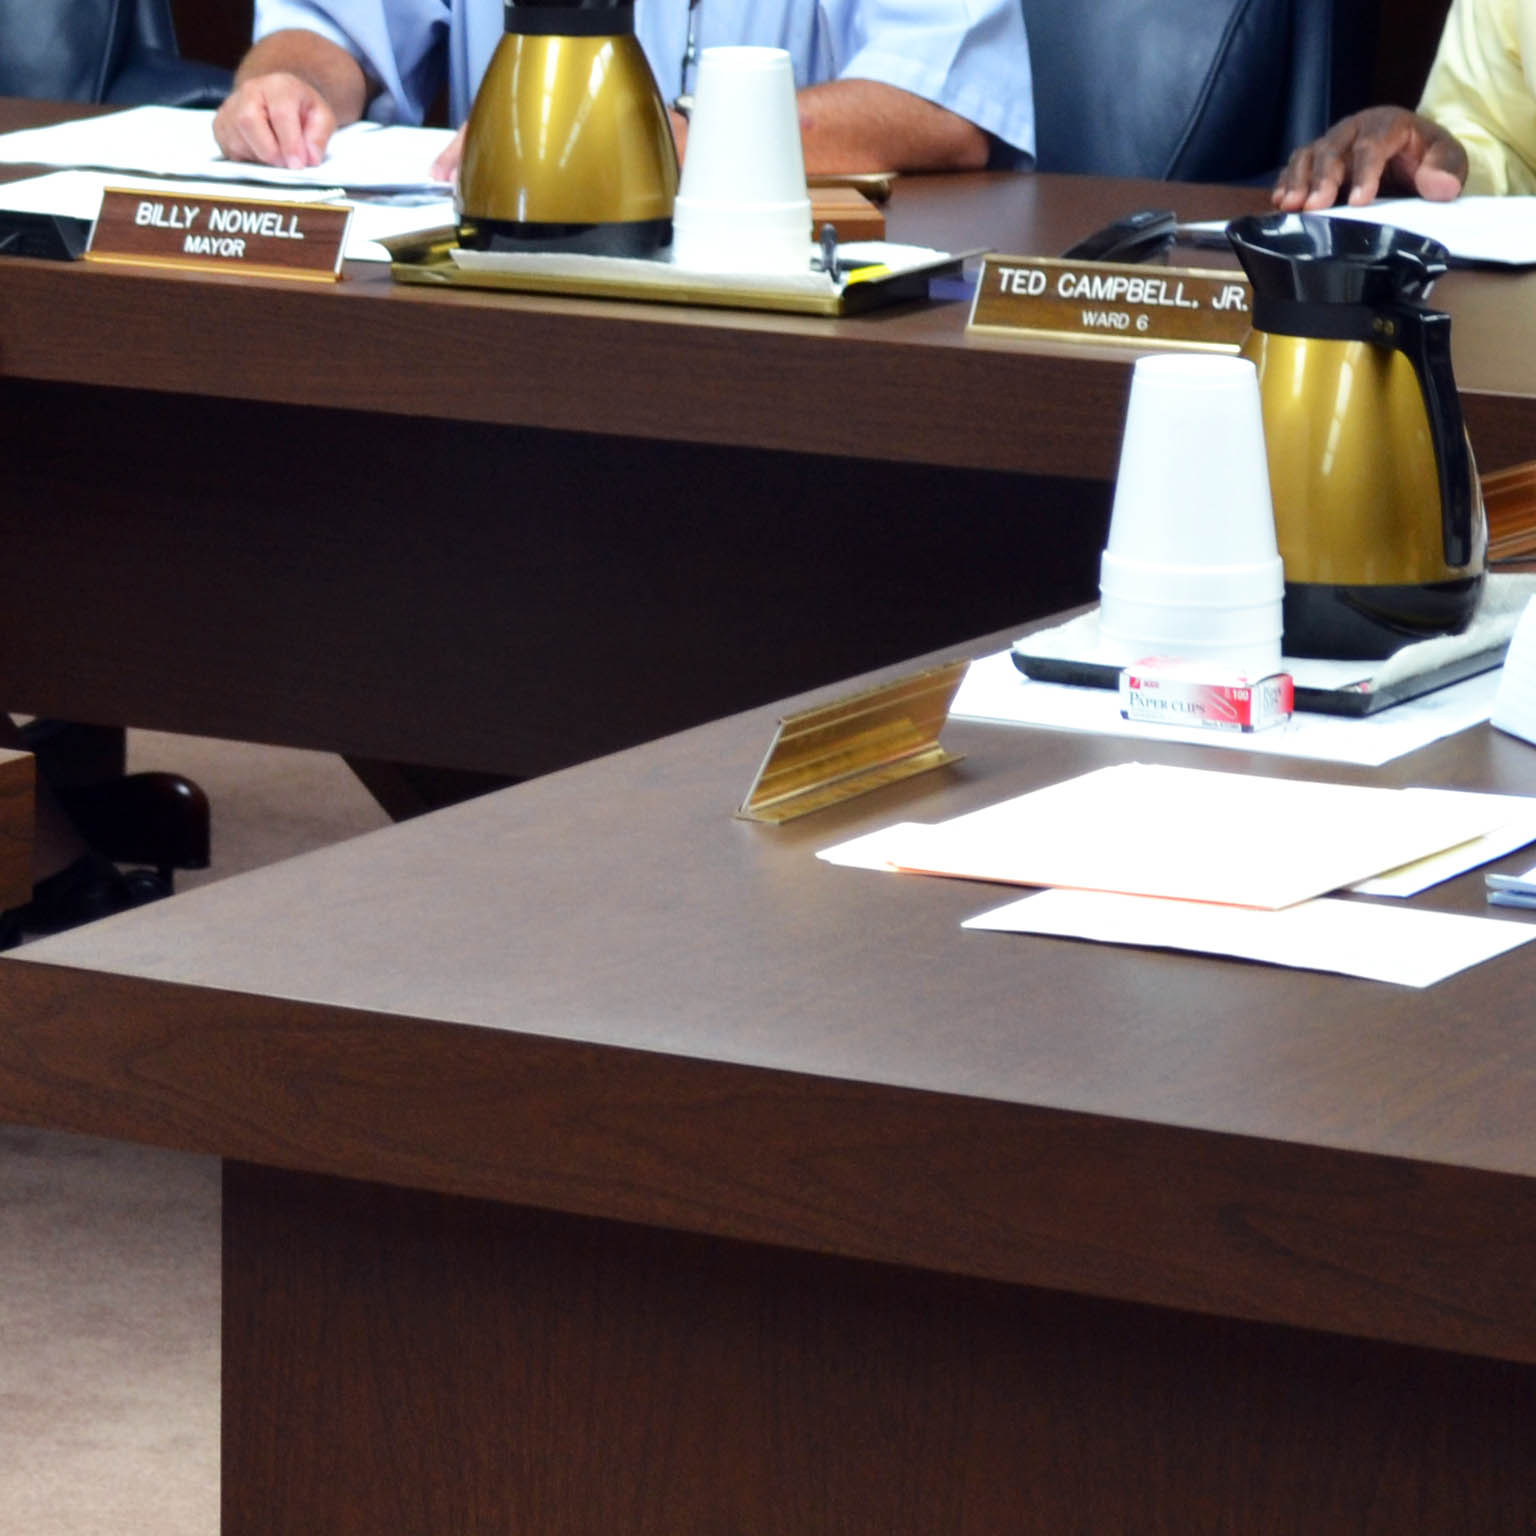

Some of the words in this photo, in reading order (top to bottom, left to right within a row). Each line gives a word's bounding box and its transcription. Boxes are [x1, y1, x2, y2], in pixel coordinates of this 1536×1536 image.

[134, 202, 201, 230] BILLY
[208, 208, 305, 240] NOWELL
[183, 235, 247, 259] MAYOR
[998, 267, 1047, 296] TED
[1211, 285, 1249, 312] JR.
[1081, 310, 1131, 330] WARD
[1135, 314, 1150, 332] 6
